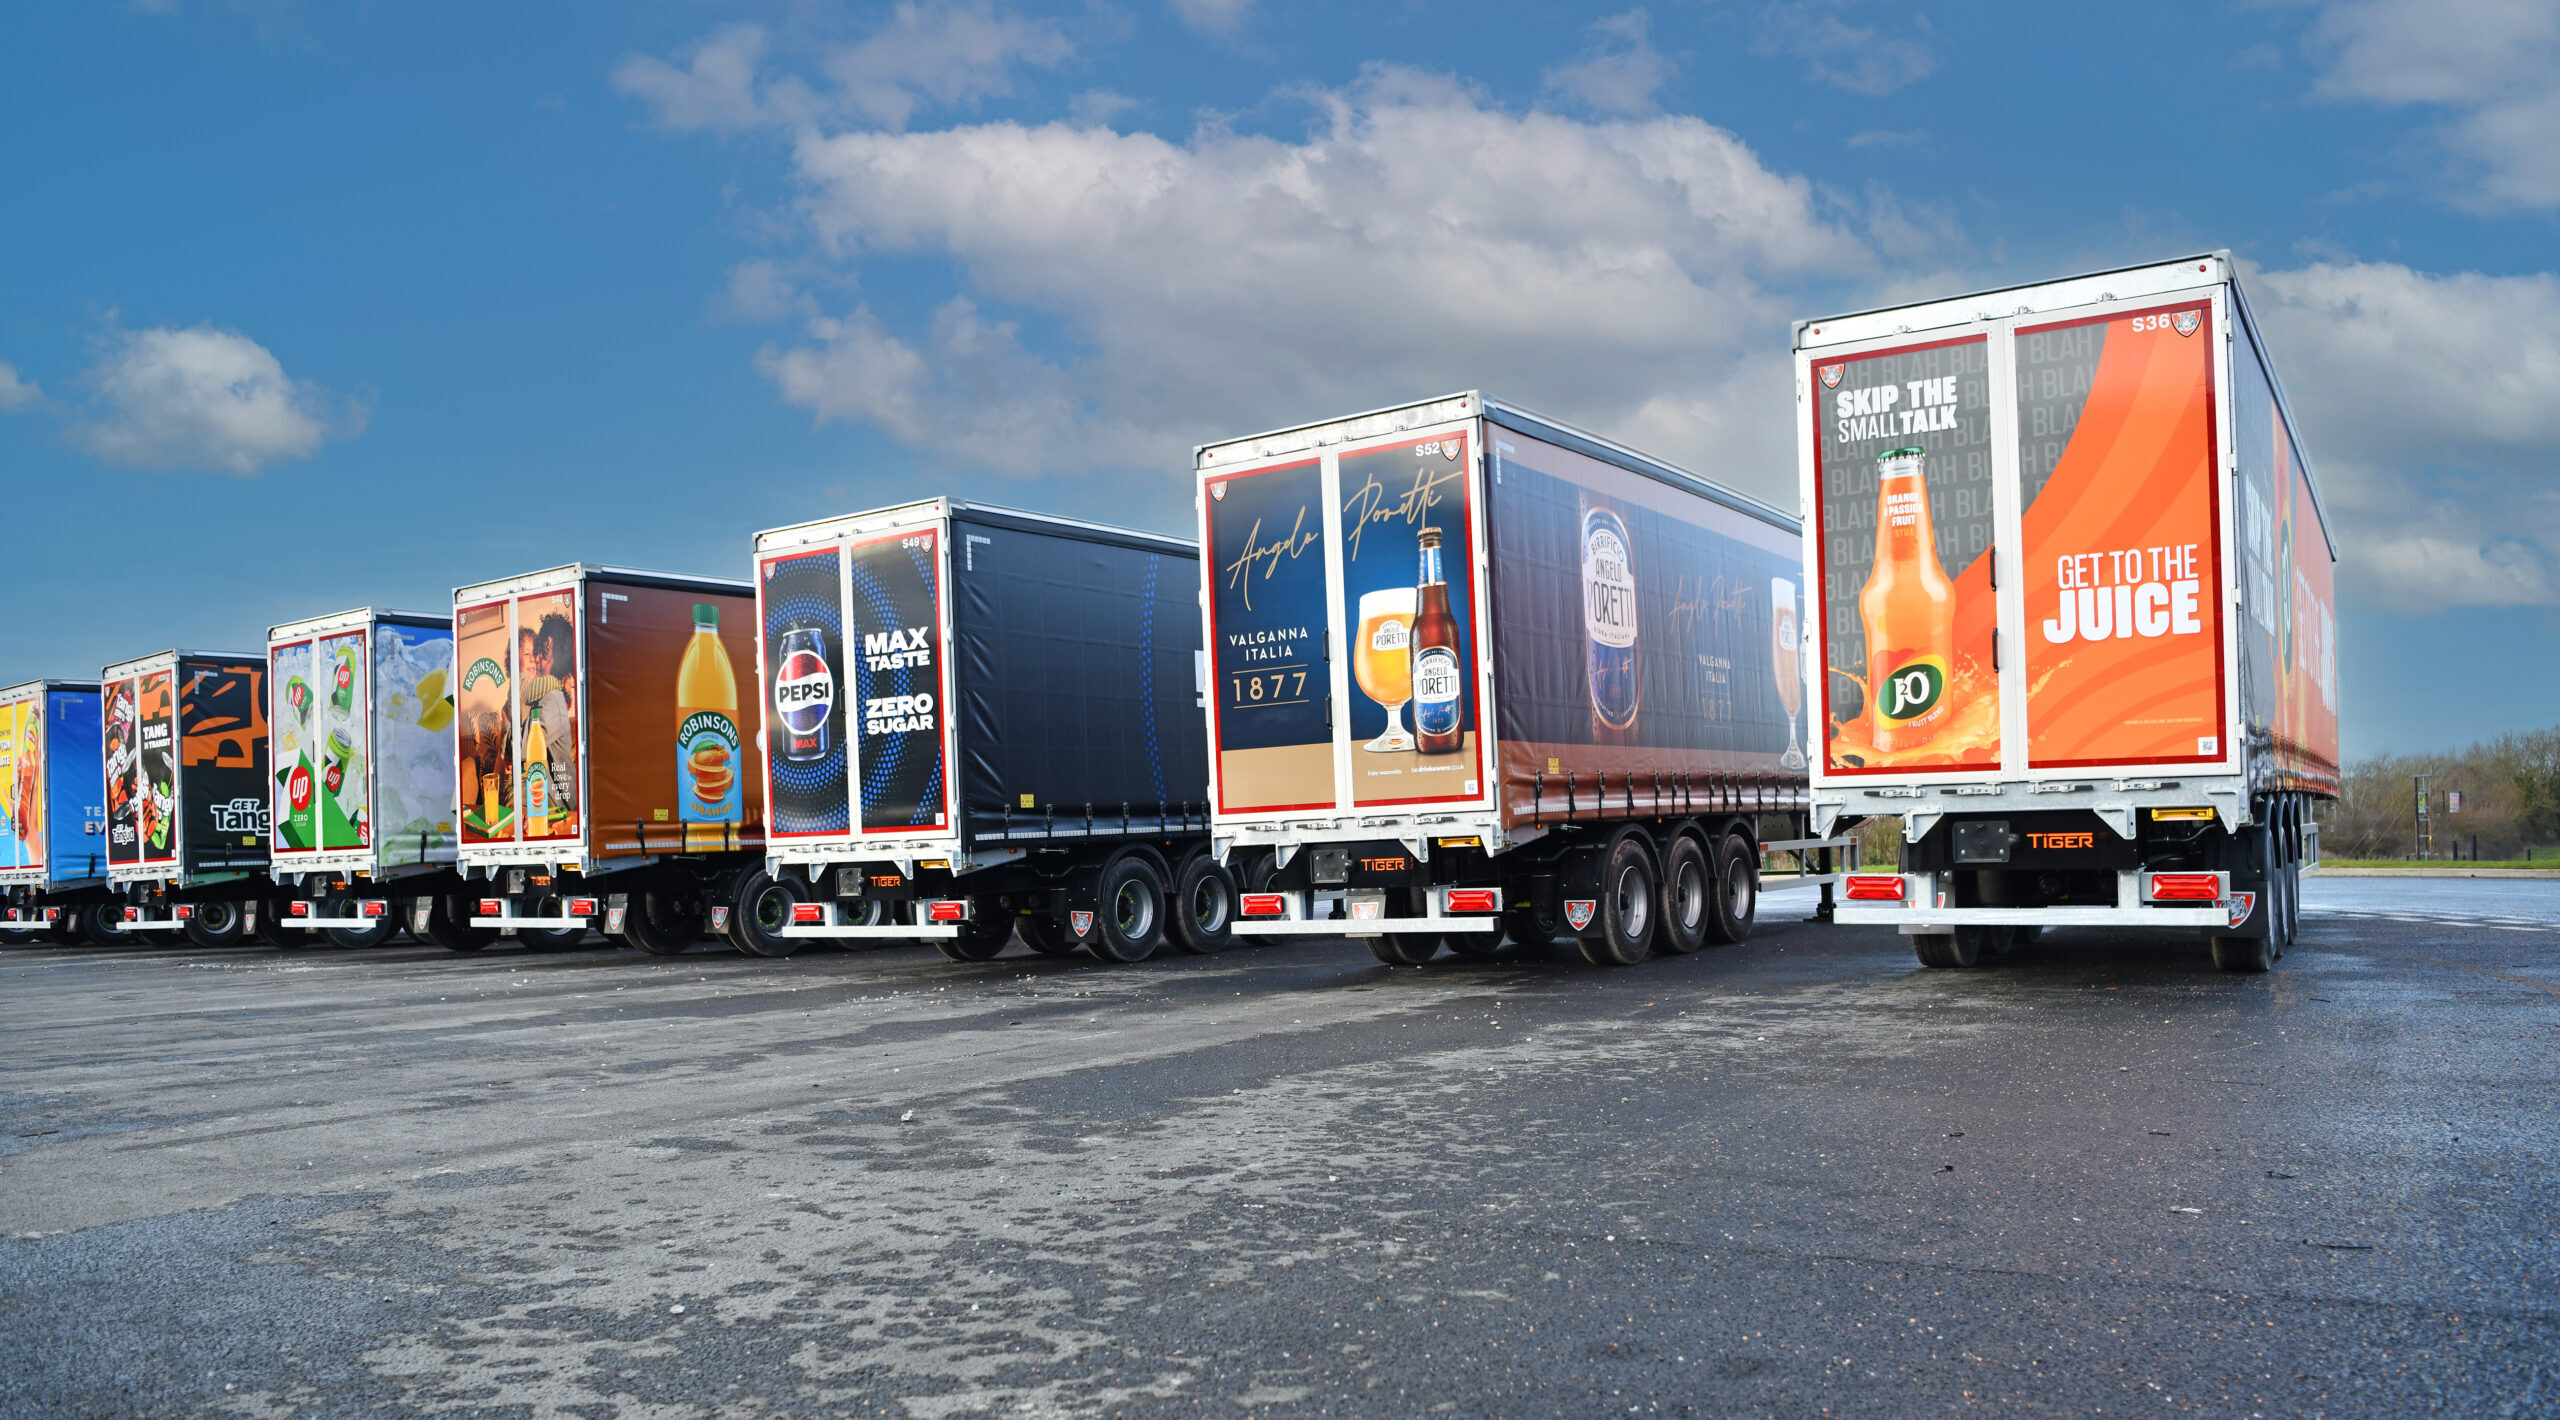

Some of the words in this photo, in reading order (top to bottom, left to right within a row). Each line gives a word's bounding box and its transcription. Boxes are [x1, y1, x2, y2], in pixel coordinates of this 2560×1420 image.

[2132, 313, 2170, 332] S36
[1951, 342, 1988, 375] BLA
[1837, 385, 1899, 419] SKIP
[1907, 375, 1958, 408] THE
[1838, 413, 1899, 444] SMALL
[1900, 404, 1958, 435] TALK
[2032, 402, 2084, 437] BLA
[1953, 414, 1991, 447] BLA
[1416, 442, 1440, 457] S52
[1956, 486, 1993, 519] BLA
[1892, 515, 1916, 527] FRUIT
[902, 536, 920, 549] S49
[1226, 505, 1319, 611] Angelo
[2057, 552, 2104, 590] GET
[2109, 548, 2142, 584] TO
[2147, 544, 2199, 581] THE
[1595, 558, 1622, 583] ANGELO
[2043, 579, 2201, 643] JUICE
[865, 626, 930, 656] MAX
[1229, 626, 1308, 647] VALGANNA
[1376, 632, 1408, 646] PORETTI
[866, 649, 931, 672] TASTE
[1245, 645, 1293, 661] ITALIA
[1698, 654, 1732, 670] VALGANNA
[465, 660, 503, 688] ROBINSONS
[1424, 667, 1448, 676] ANGELO
[1705, 670, 1726, 684] ITALIA
[779, 682, 830, 703] PEPSI
[1233, 672, 1306, 702] 1877
[866, 693, 934, 719] ZERO
[143, 723, 168, 740] TANG
[680, 714, 738, 747] ROBINSONS
[867, 714, 934, 735] SUGAR
[793, 737, 818, 749] MAX
[551, 762, 566, 772] Real
[554, 772, 568, 781] love
[551, 782, 570, 792] every
[555, 792, 571, 801] drop
[84, 806, 105, 817] TE
[231, 800, 258, 810] GET
[690, 801, 733, 816] ORANGE
[294, 814, 308, 822] ZERO
